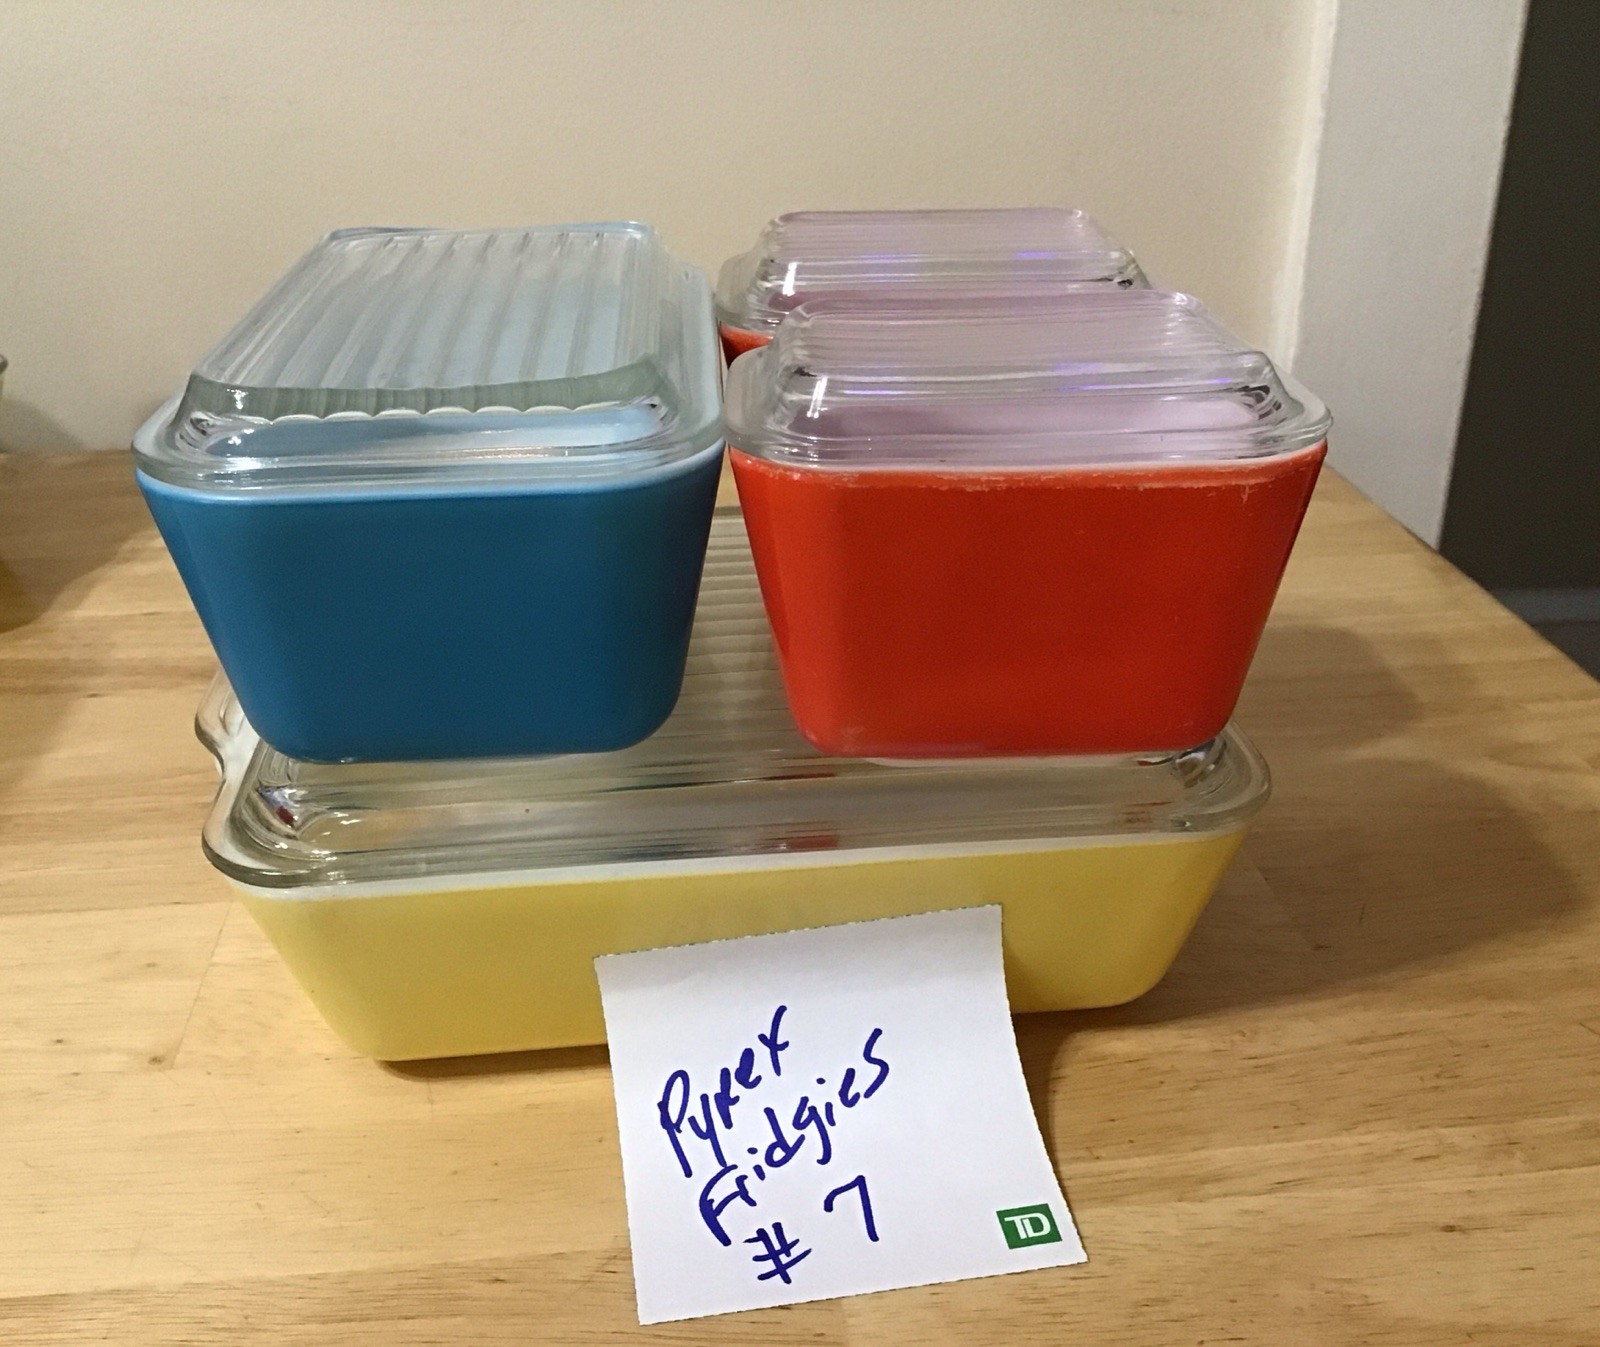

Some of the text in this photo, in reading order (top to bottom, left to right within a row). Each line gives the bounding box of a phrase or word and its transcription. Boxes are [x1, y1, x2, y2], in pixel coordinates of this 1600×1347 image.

[656, 1004, 790, 1179] Pyrex
[698, 1027, 890, 1247] Fridgies
[823, 1174, 880, 1243] 7
[1003, 1212, 1052, 1240] TD
